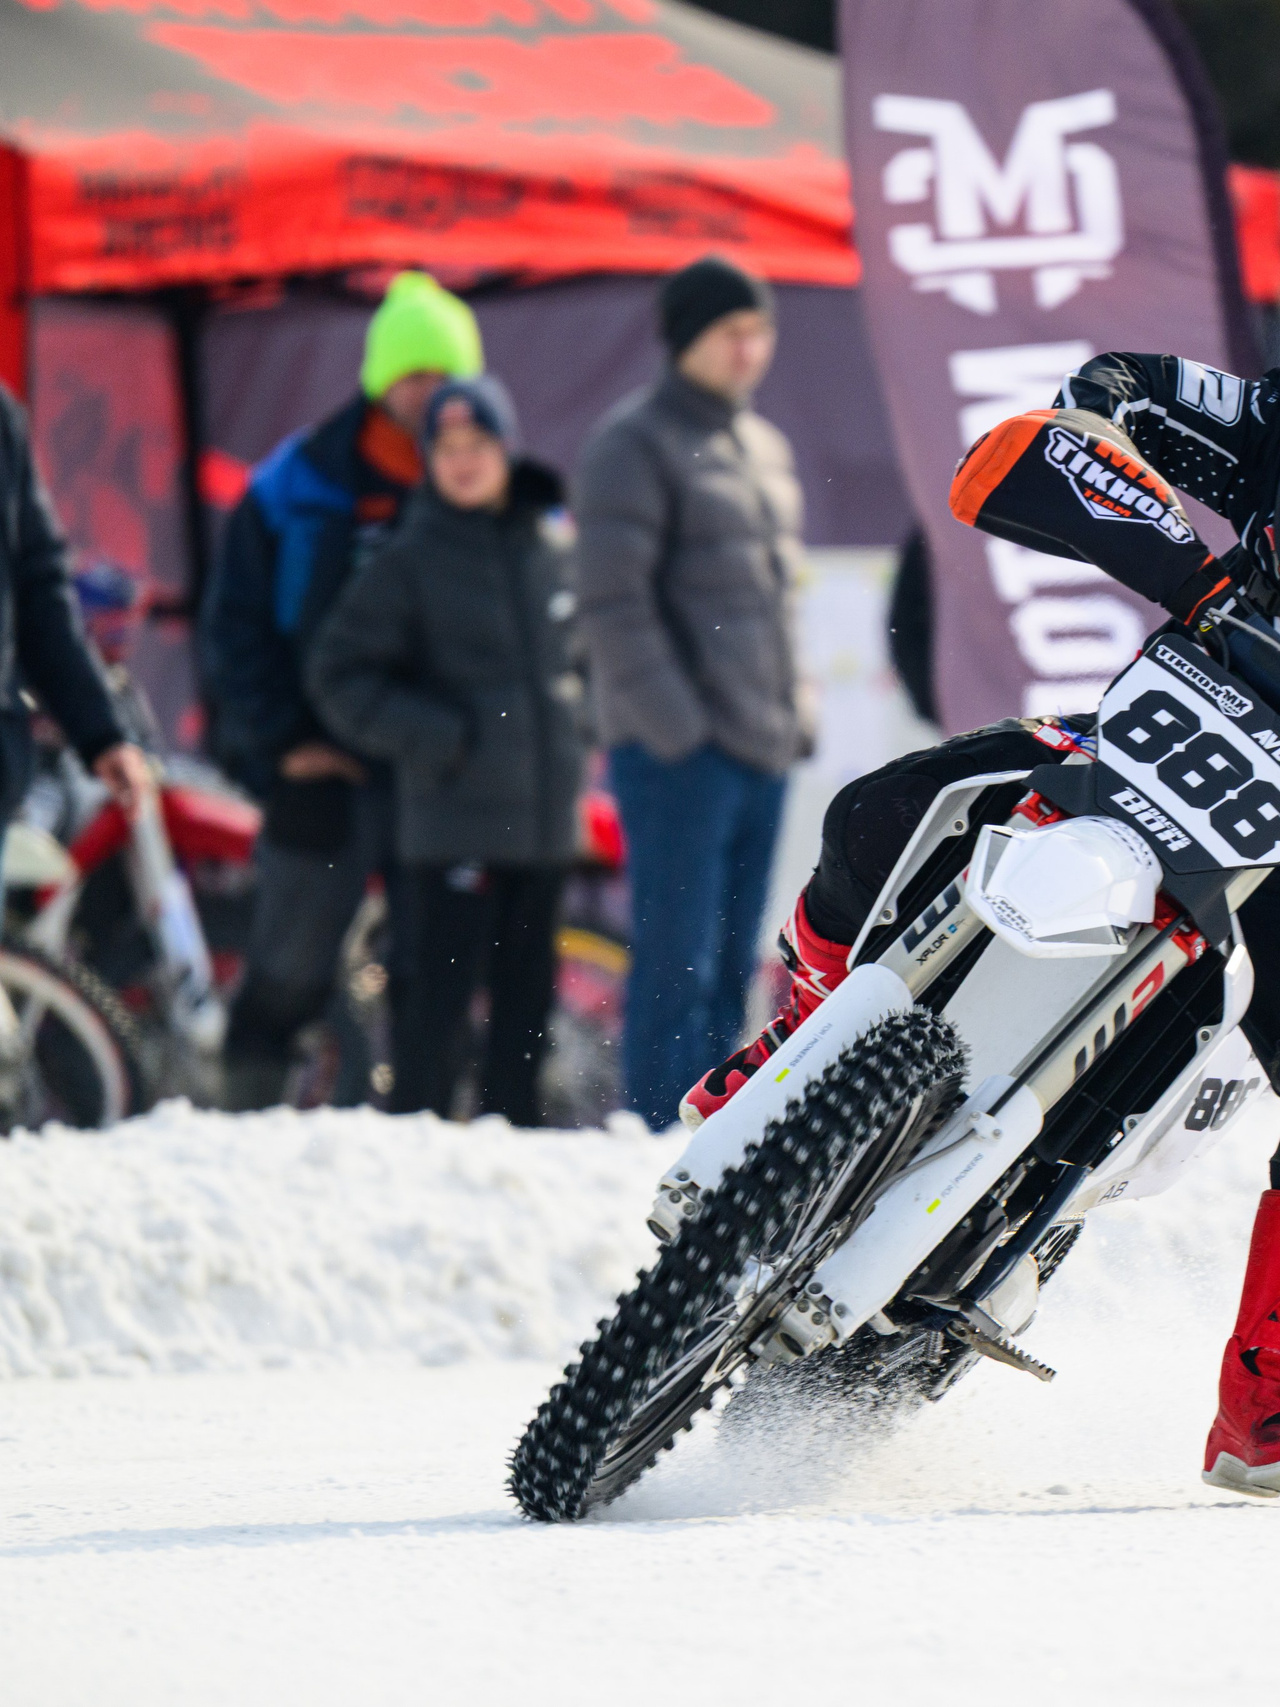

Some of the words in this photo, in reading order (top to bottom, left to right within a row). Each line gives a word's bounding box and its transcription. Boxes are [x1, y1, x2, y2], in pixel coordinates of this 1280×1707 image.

[1177, 356, 1246, 427] 2
[1049, 438, 1191, 541] TIKHON
[1084, 488, 1133, 517] TEAM
[1156, 645, 1221, 697] TIKHON
